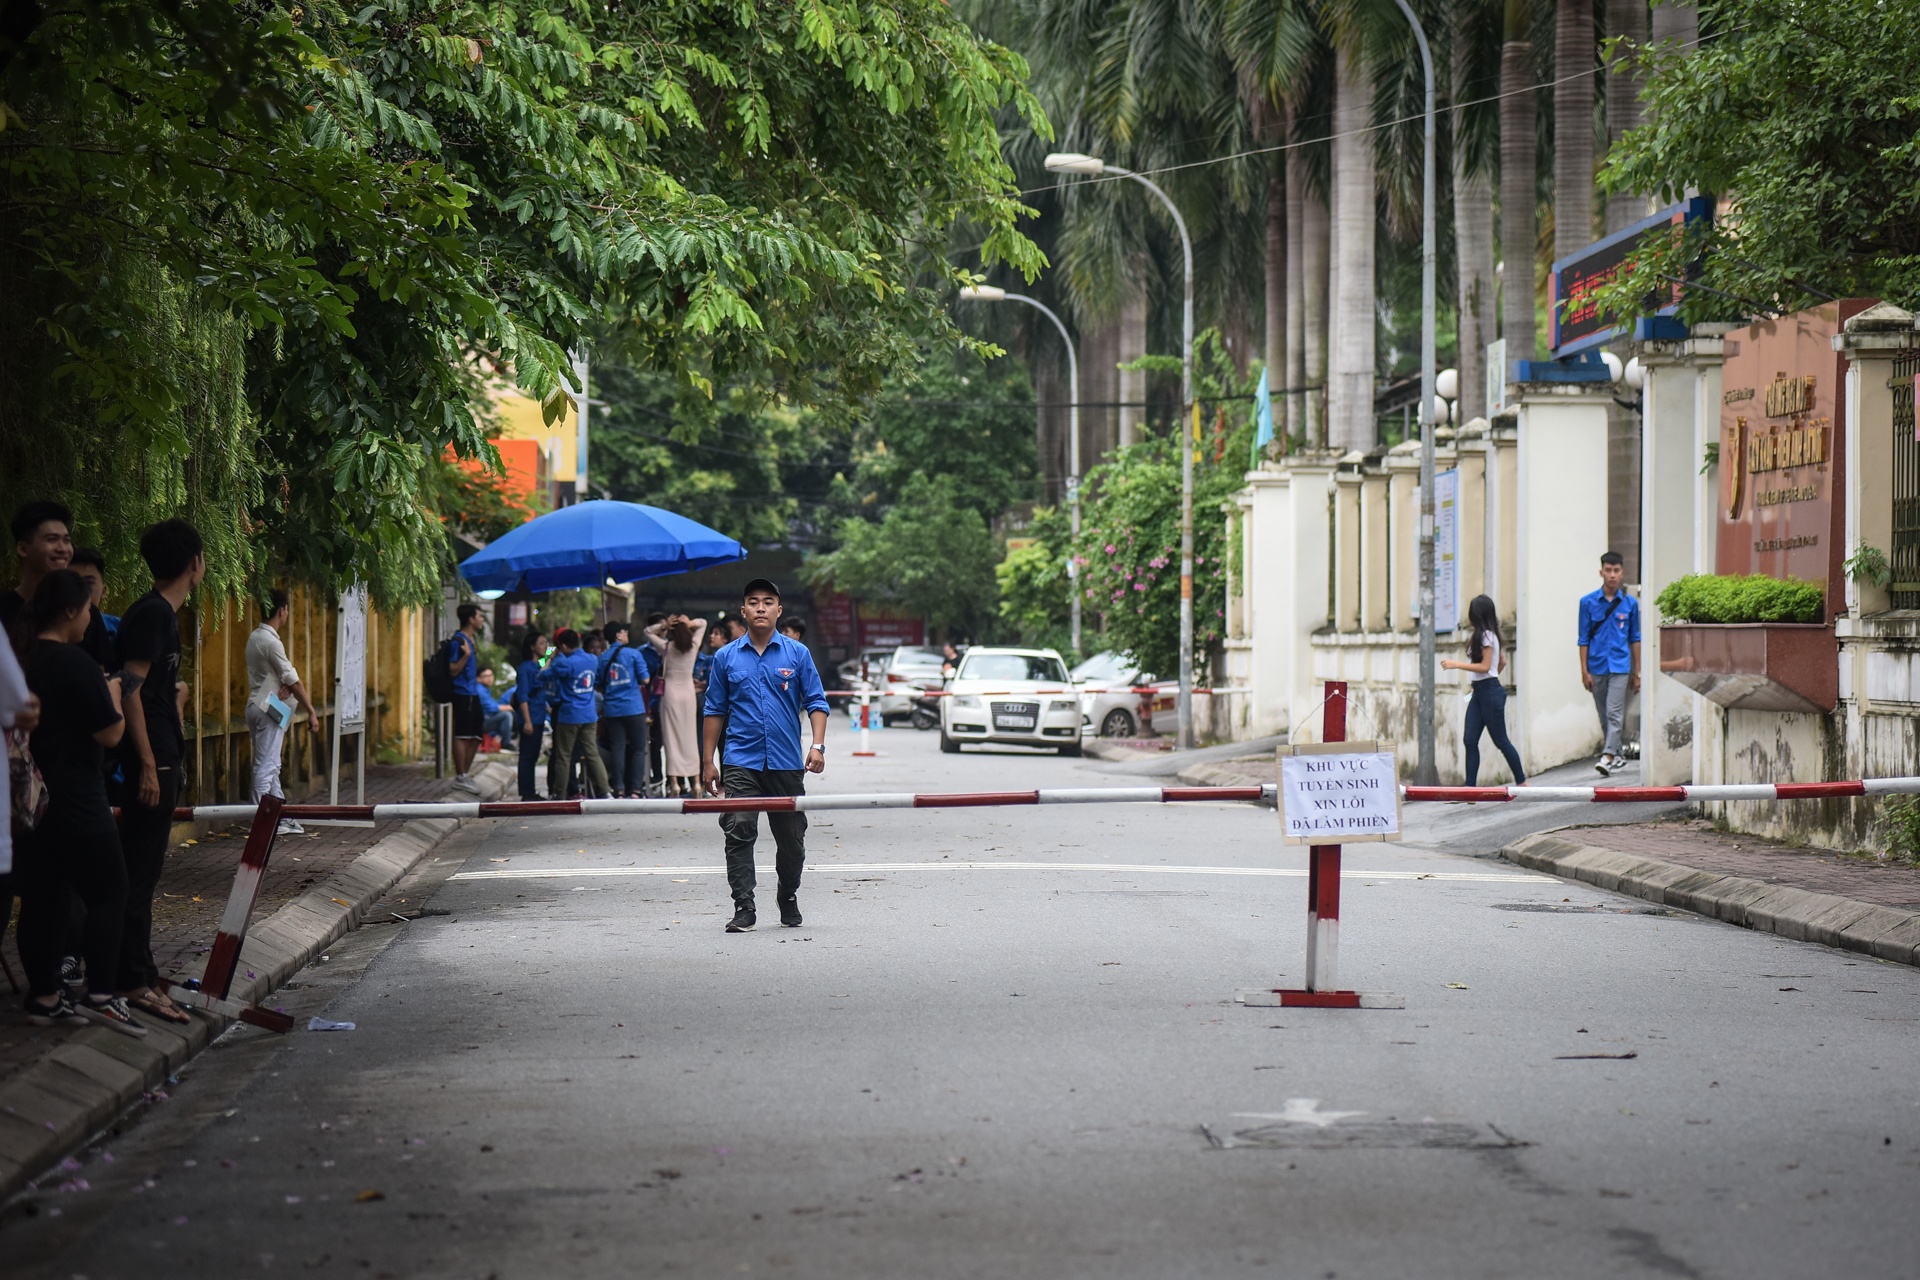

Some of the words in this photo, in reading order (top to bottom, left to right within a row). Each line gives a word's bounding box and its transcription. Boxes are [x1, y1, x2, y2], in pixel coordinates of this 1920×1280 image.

[1306, 761, 1336, 773] KHU
[1339, 758, 1369, 773] VỰC
[1347, 778, 1379, 790] SINH
[1314, 799, 1338, 811] XIN
[1292, 817, 1311, 830] ĐÃ
[1315, 814, 1345, 829] LÀM
